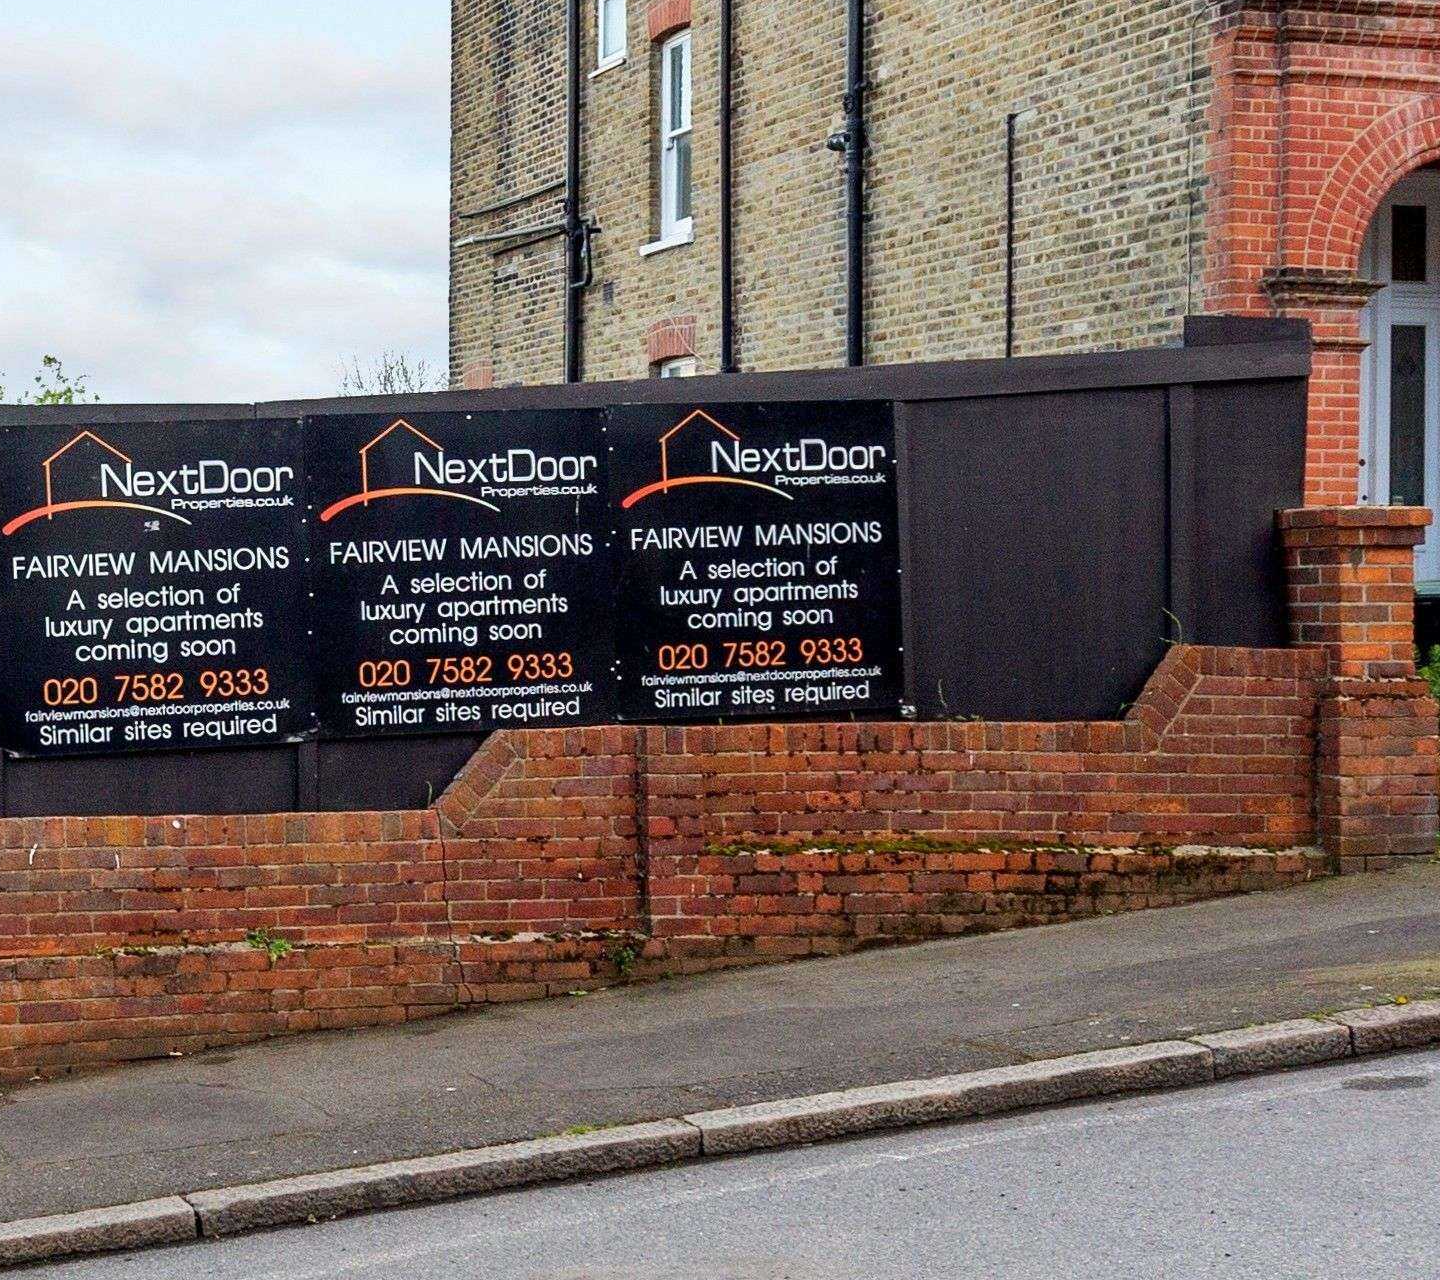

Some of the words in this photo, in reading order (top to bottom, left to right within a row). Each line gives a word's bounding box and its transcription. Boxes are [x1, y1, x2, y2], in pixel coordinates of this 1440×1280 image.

[414, 449, 597, 485] NextDoor
[711, 438, 886, 473] NextDoor
[101, 460, 293, 497] NextDoor
[481, 484, 597, 497] Properties.co.uk
[775, 473, 886, 486] Properties.co.uk
[171, 495, 294, 510] Properties.co.uk
[330, 539, 447, 564] FAIRVIEW
[460, 534, 593, 560] MANSIONS
[631, 526, 743, 550] FAIRVIEW
[755, 521, 882, 546] MANSIONS
[12, 552, 136, 579] FAIRVIEW
[150, 547, 289, 574] MANSIONS
[680, 560, 697, 580] A
[708, 558, 805, 579] selection
[816, 556, 839, 575] of
[381, 575, 399, 595] A
[411, 572, 512, 593] selection
[524, 569, 546, 589] of
[660, 586, 722, 608] luxury
[734, 580, 858, 606] apartments
[66, 590, 85, 610] A
[98, 586, 204, 608] selection
[217, 583, 241, 604] of
[360, 601, 425, 623] luxury
[438, 594, 568, 621] apartments
[45, 617, 112, 639] luxury
[126, 608, 263, 636] apartments
[688, 608, 771, 630] coming
[783, 609, 833, 625] soon
[390, 623, 478, 646] coming
[489, 623, 542, 640] soon
[76, 639, 168, 663] coming
[181, 639, 236, 657] soon
[658, 644, 708, 670] 020
[723, 641, 786, 667] 7582
[801, 637, 863, 663] 9333
[359, 660, 410, 687] 020
[427, 656, 492, 684] 7582
[508, 653, 573, 679] 9333
[642, 666, 881, 686] fairviewmansions@nextdoorproperties.co.uk
[44, 677, 98, 706] 020
[115, 673, 184, 701] 7582
[200, 669, 269, 697] 9333
[342, 682, 593, 704] fairviewmansions@nextdoorproperties.co.uk
[655, 689, 722, 708] Similar
[732, 686, 774, 705] sites
[785, 681, 870, 705] required
[25, 698, 290, 723] fairviewmansions@nextdoorproperties.co.uk
[356, 706, 425, 726] Similar
[436, 702, 481, 722] sites
[492, 698, 580, 721] required
[40, 724, 113, 745] Similar
[125, 720, 171, 741] sites
[183, 715, 277, 740] required
